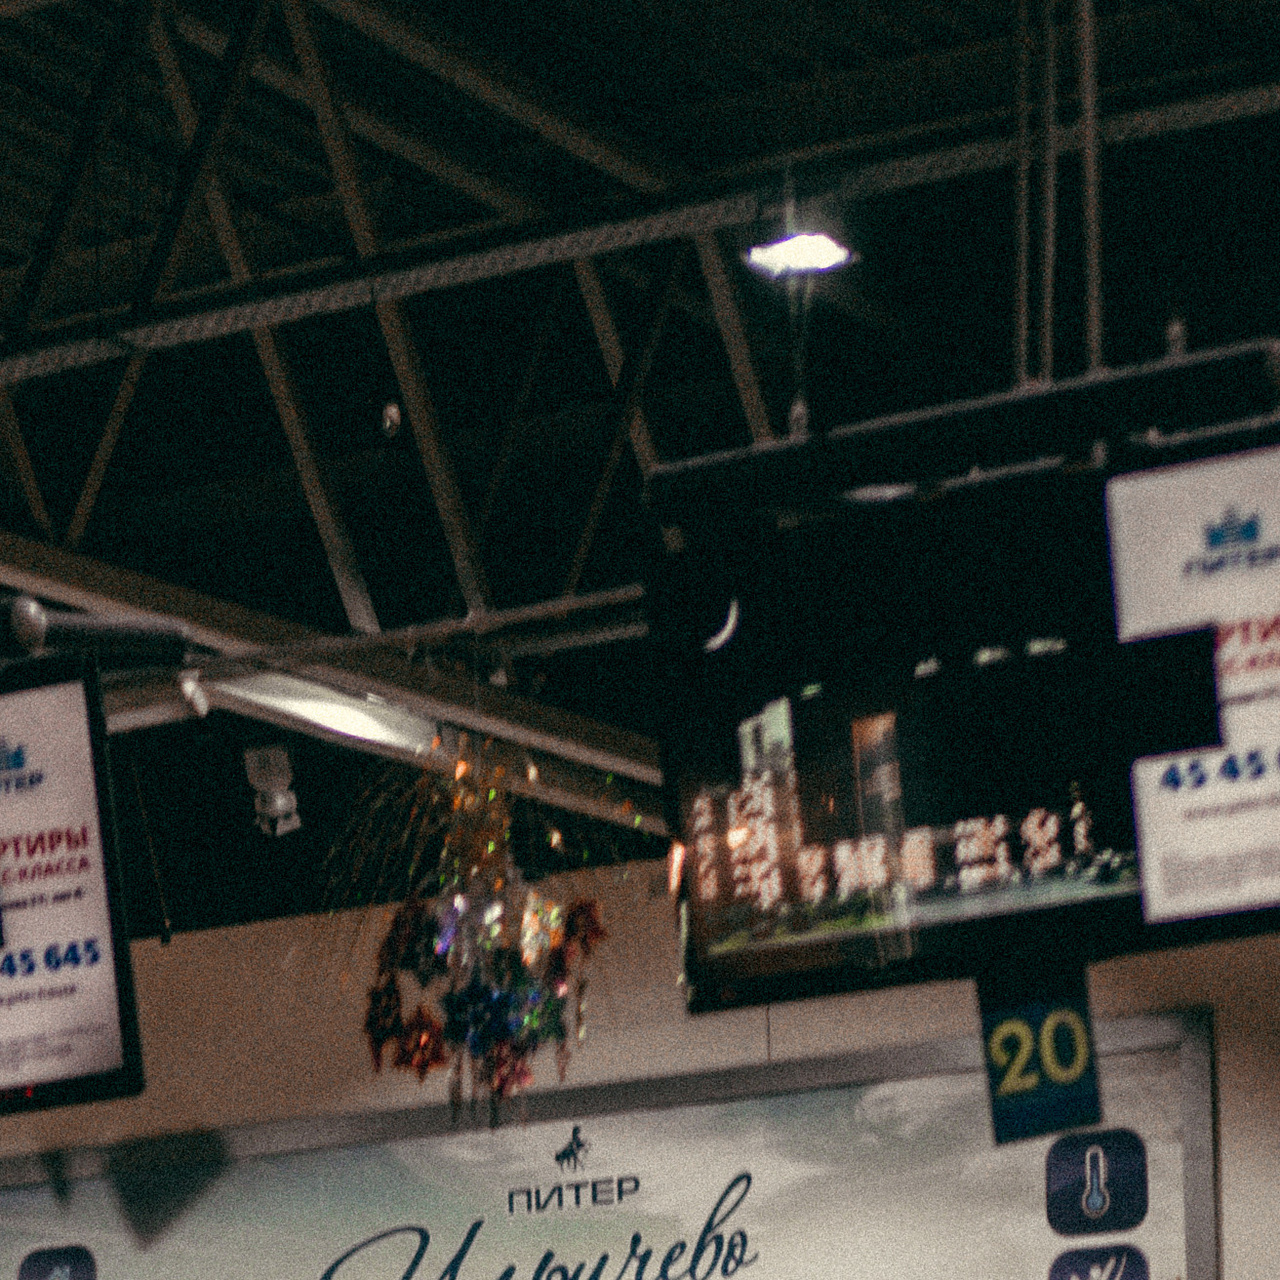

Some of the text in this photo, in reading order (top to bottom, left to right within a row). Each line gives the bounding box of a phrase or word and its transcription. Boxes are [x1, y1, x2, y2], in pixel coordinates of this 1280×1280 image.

[1160, 750, 1266, 792] 45 45
[0, 949, 35, 978] 45
[44, 937, 100, 972] 645
[990, 1008, 1088, 1095] 20
[508, 1175, 640, 1215] ПИТЕР
